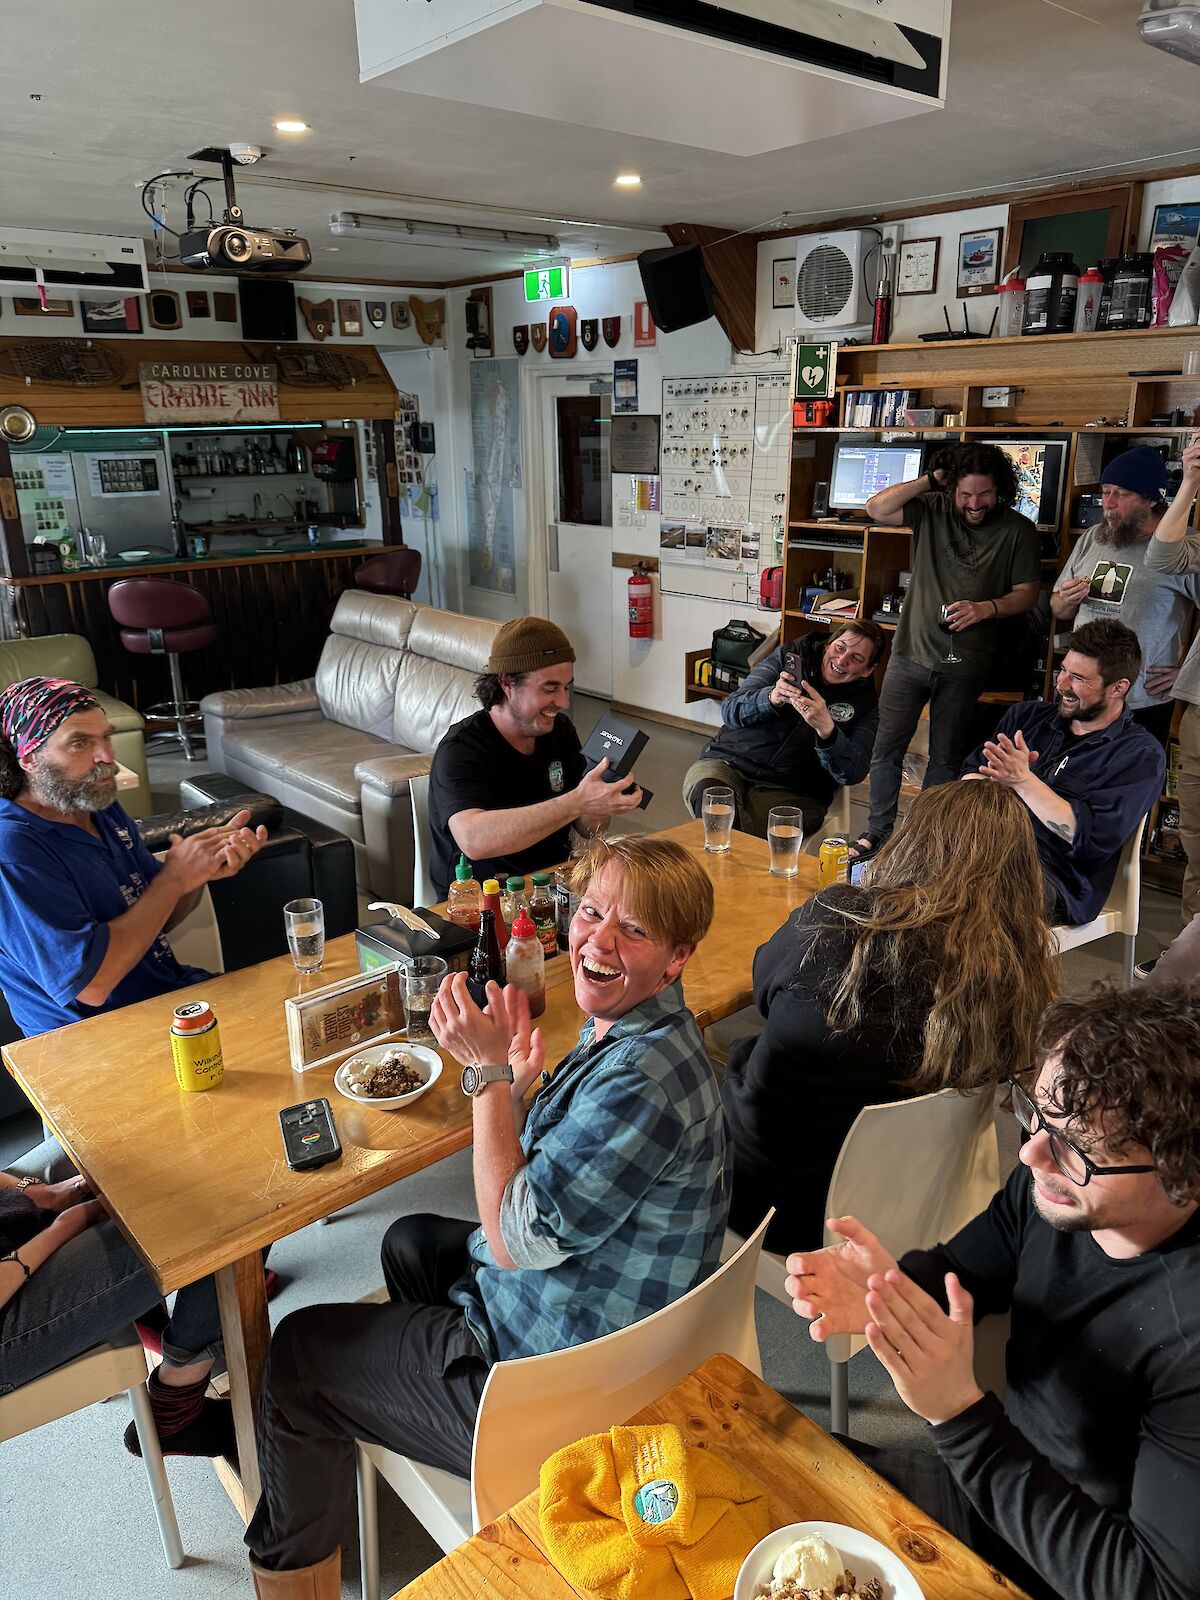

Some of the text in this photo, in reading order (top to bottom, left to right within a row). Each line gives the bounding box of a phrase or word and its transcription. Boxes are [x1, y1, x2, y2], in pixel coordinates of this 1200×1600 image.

[152, 364, 270, 379] CAROLINE COVE
[323, 1012, 338, 1044] BERRY
[336, 1004, 352, 1040] FOREST
